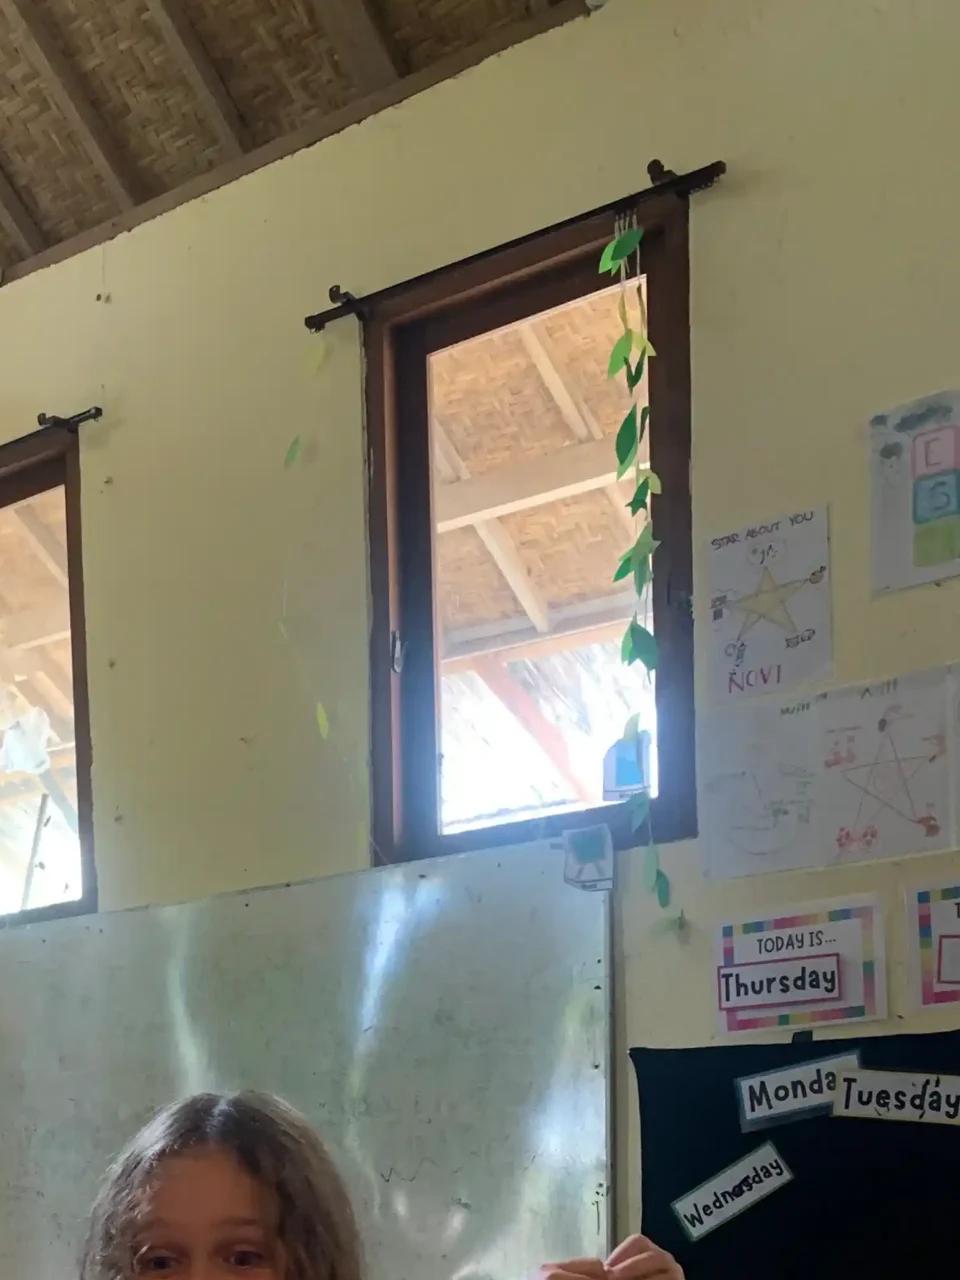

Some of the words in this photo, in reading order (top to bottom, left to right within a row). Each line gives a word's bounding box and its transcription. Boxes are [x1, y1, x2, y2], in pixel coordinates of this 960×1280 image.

[710, 532, 741, 552] STAR
[744, 519, 782, 541] ABOUT
[787, 510, 814, 528] YOU
[727, 662, 782, 694] NOVI
[755, 933, 805, 955] TODAY
[721, 966, 836, 1002] Thursday
[748, 1067, 837, 1113] Monda
[842, 1074, 960, 1119] Tuesday
